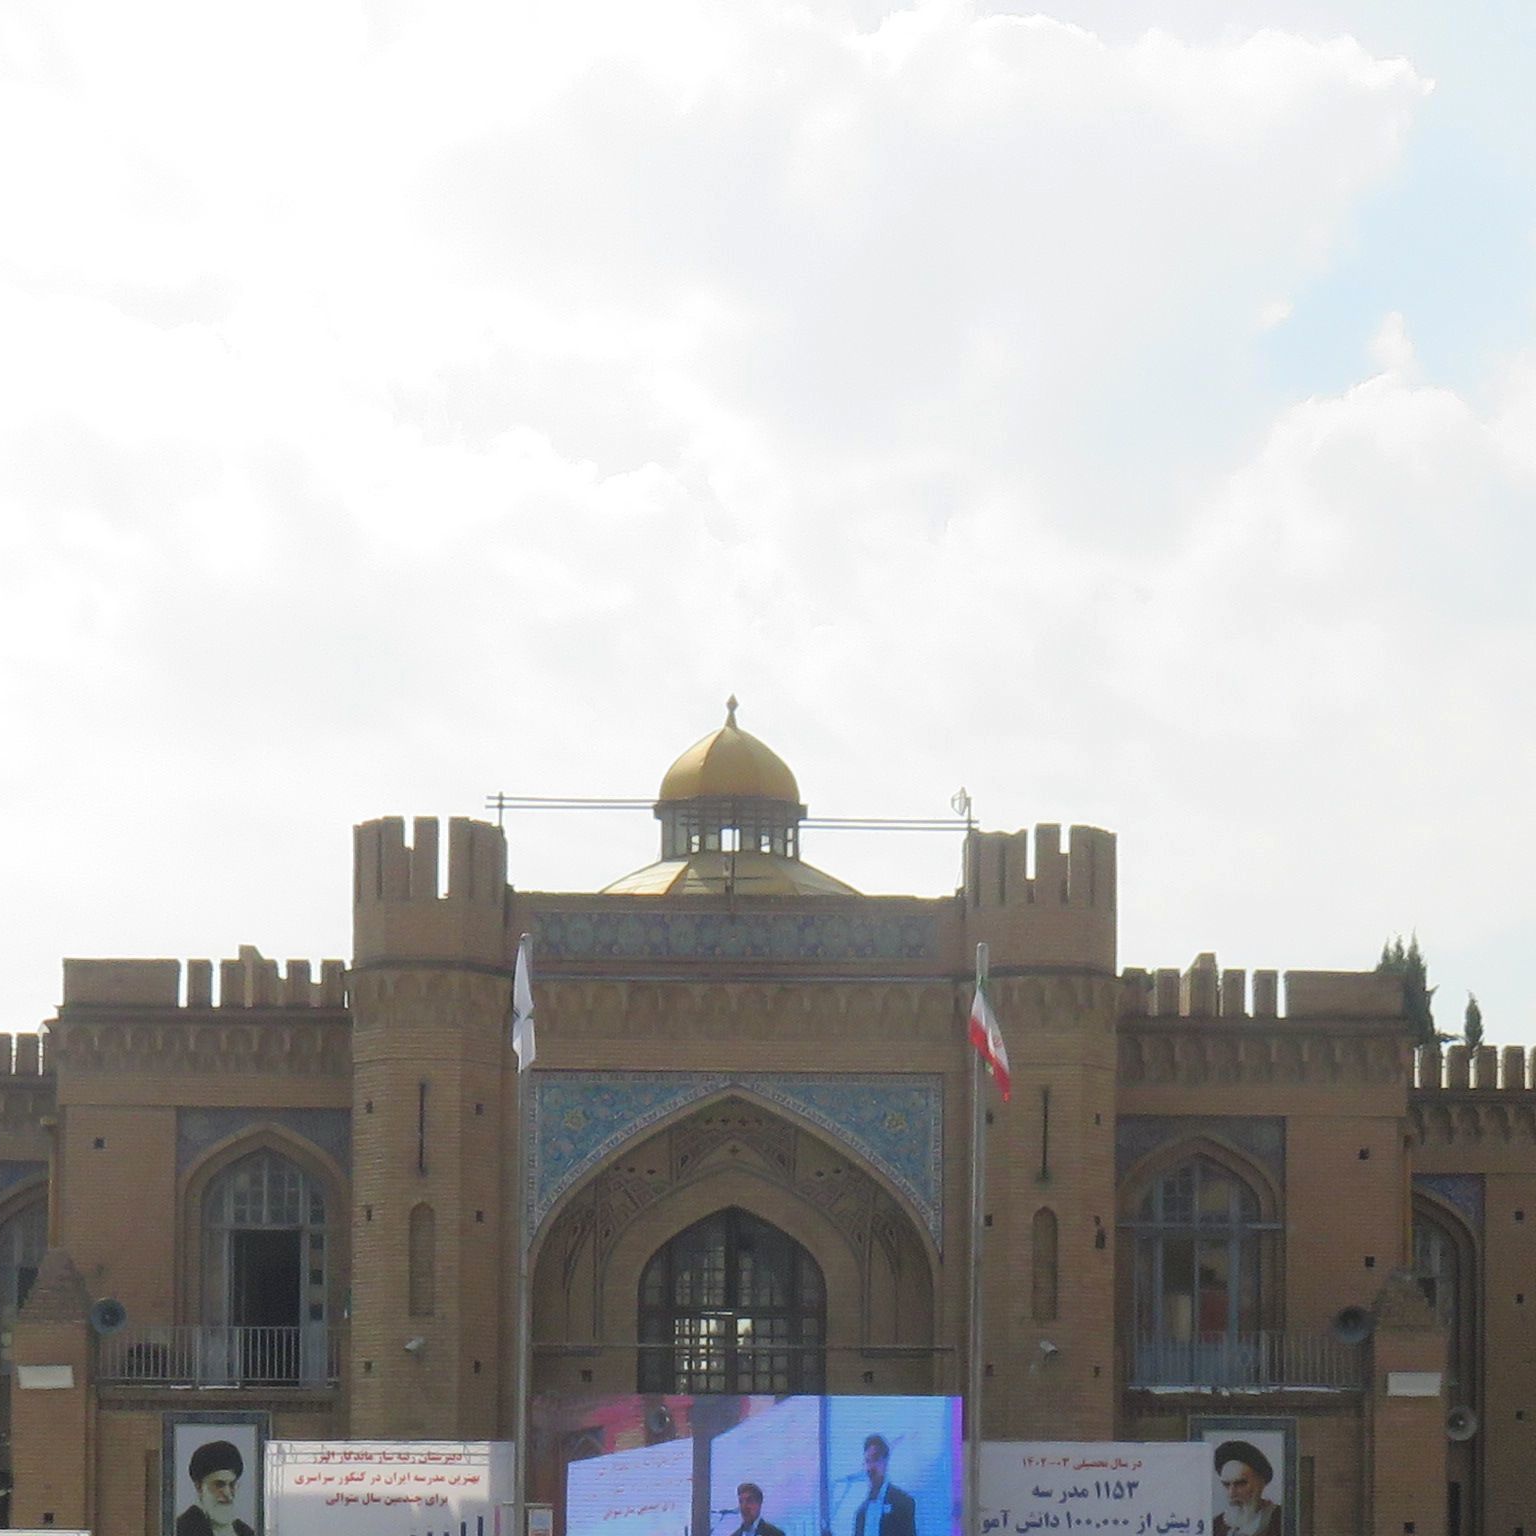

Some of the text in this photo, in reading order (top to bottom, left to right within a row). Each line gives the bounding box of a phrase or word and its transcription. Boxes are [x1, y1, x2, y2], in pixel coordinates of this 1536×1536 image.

[312, 1450, 336, 1464] البرز
[418, 1450, 463, 1464] دبیرستان
[1111, 1458, 1128, 1471] سال
[1131, 1459, 1143, 1471] در
[294, 1471, 480, 1486] بهترین مدرسه ایران در کنکور سراسری
[1094, 1480, 1140, 1500] ۱۱۵۳
[325, 1492, 448, 1507] برای چندمین سال متوالی
[1015, 1511, 1060, 1534] دانش
[1136, 1512, 1152, 1535] از
[1156, 1511, 1190, 1534] بیش
[1195, 1519, 1204, 1535] و
